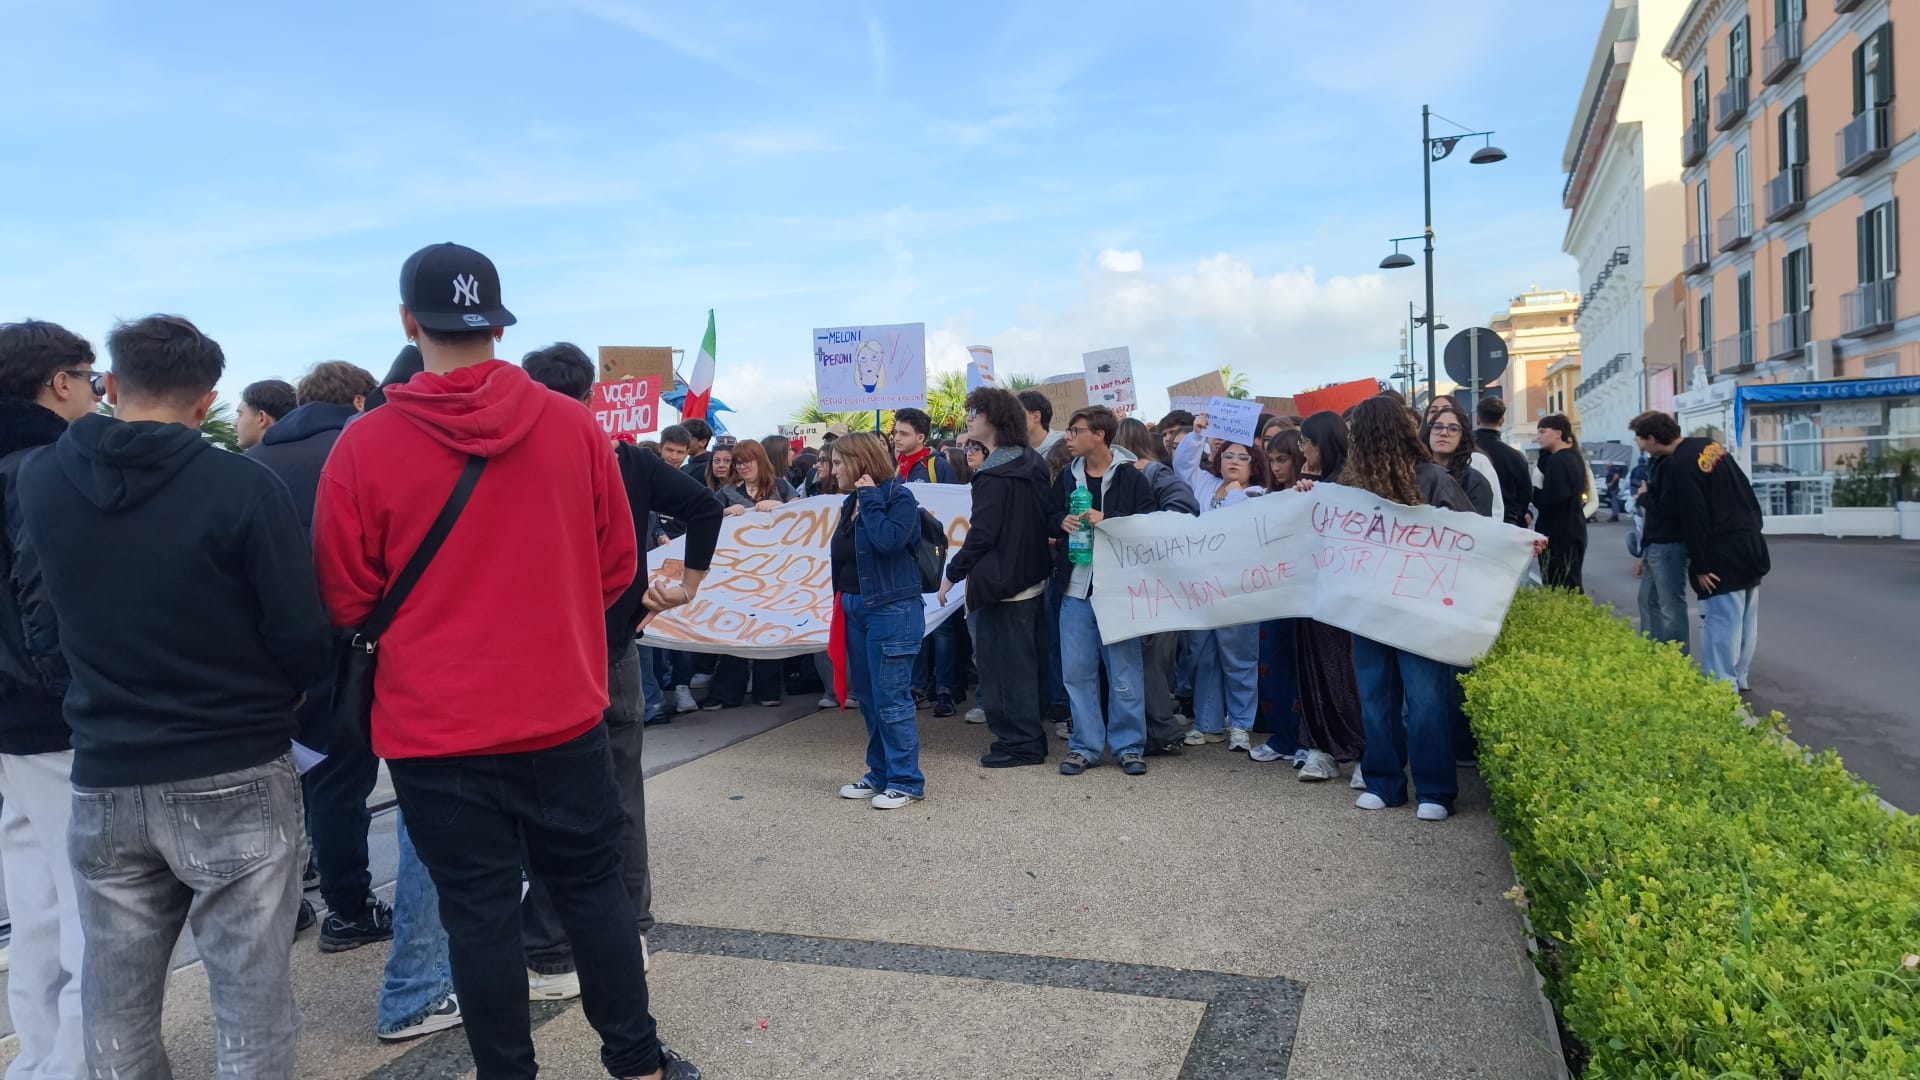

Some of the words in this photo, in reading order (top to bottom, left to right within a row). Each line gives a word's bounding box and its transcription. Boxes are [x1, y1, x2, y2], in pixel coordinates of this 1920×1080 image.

[602, 380, 648, 404] VOGLIO
[596, 404, 651, 433] FUTURO
[1107, 533, 1226, 568] VOGLIAMO
[1254, 514, 1294, 546] IL
[1128, 578, 1181, 620] MA
[1179, 575, 1227, 610] NON
[1240, 562, 1297, 594] COME
[1391, 553, 1462, 606] EX!
